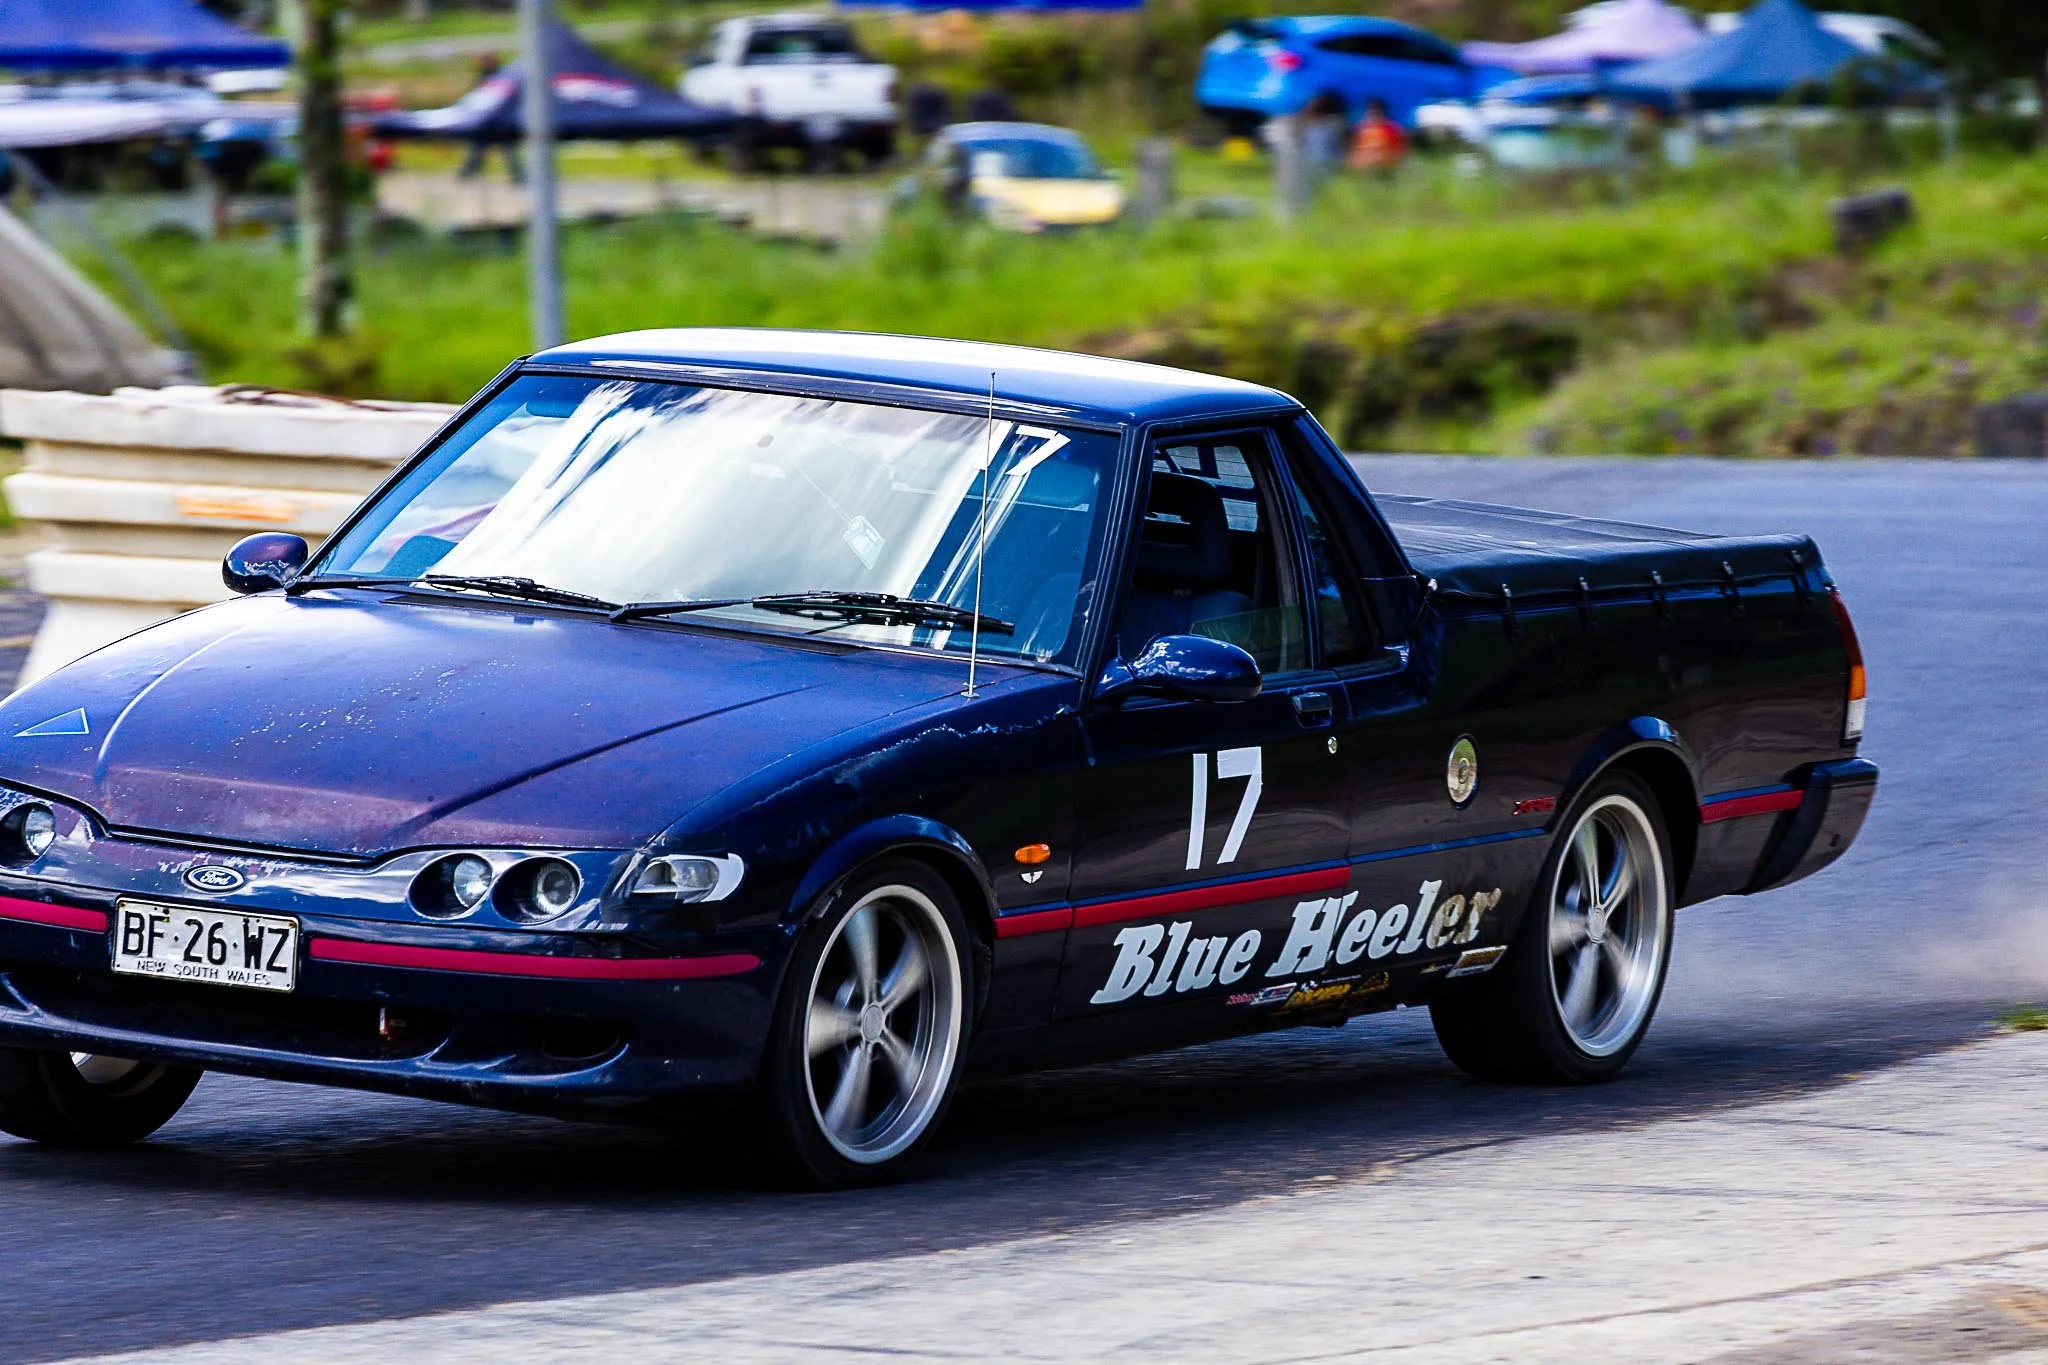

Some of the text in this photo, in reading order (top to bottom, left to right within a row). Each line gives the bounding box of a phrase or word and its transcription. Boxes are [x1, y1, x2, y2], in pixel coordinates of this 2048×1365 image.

[1186, 746, 1263, 870] 17
[200, 870, 231, 885] Ford
[137, 960, 271, 986] NEW SOUTH WALES
[1090, 880, 1502, 1004] Blue Heeler
